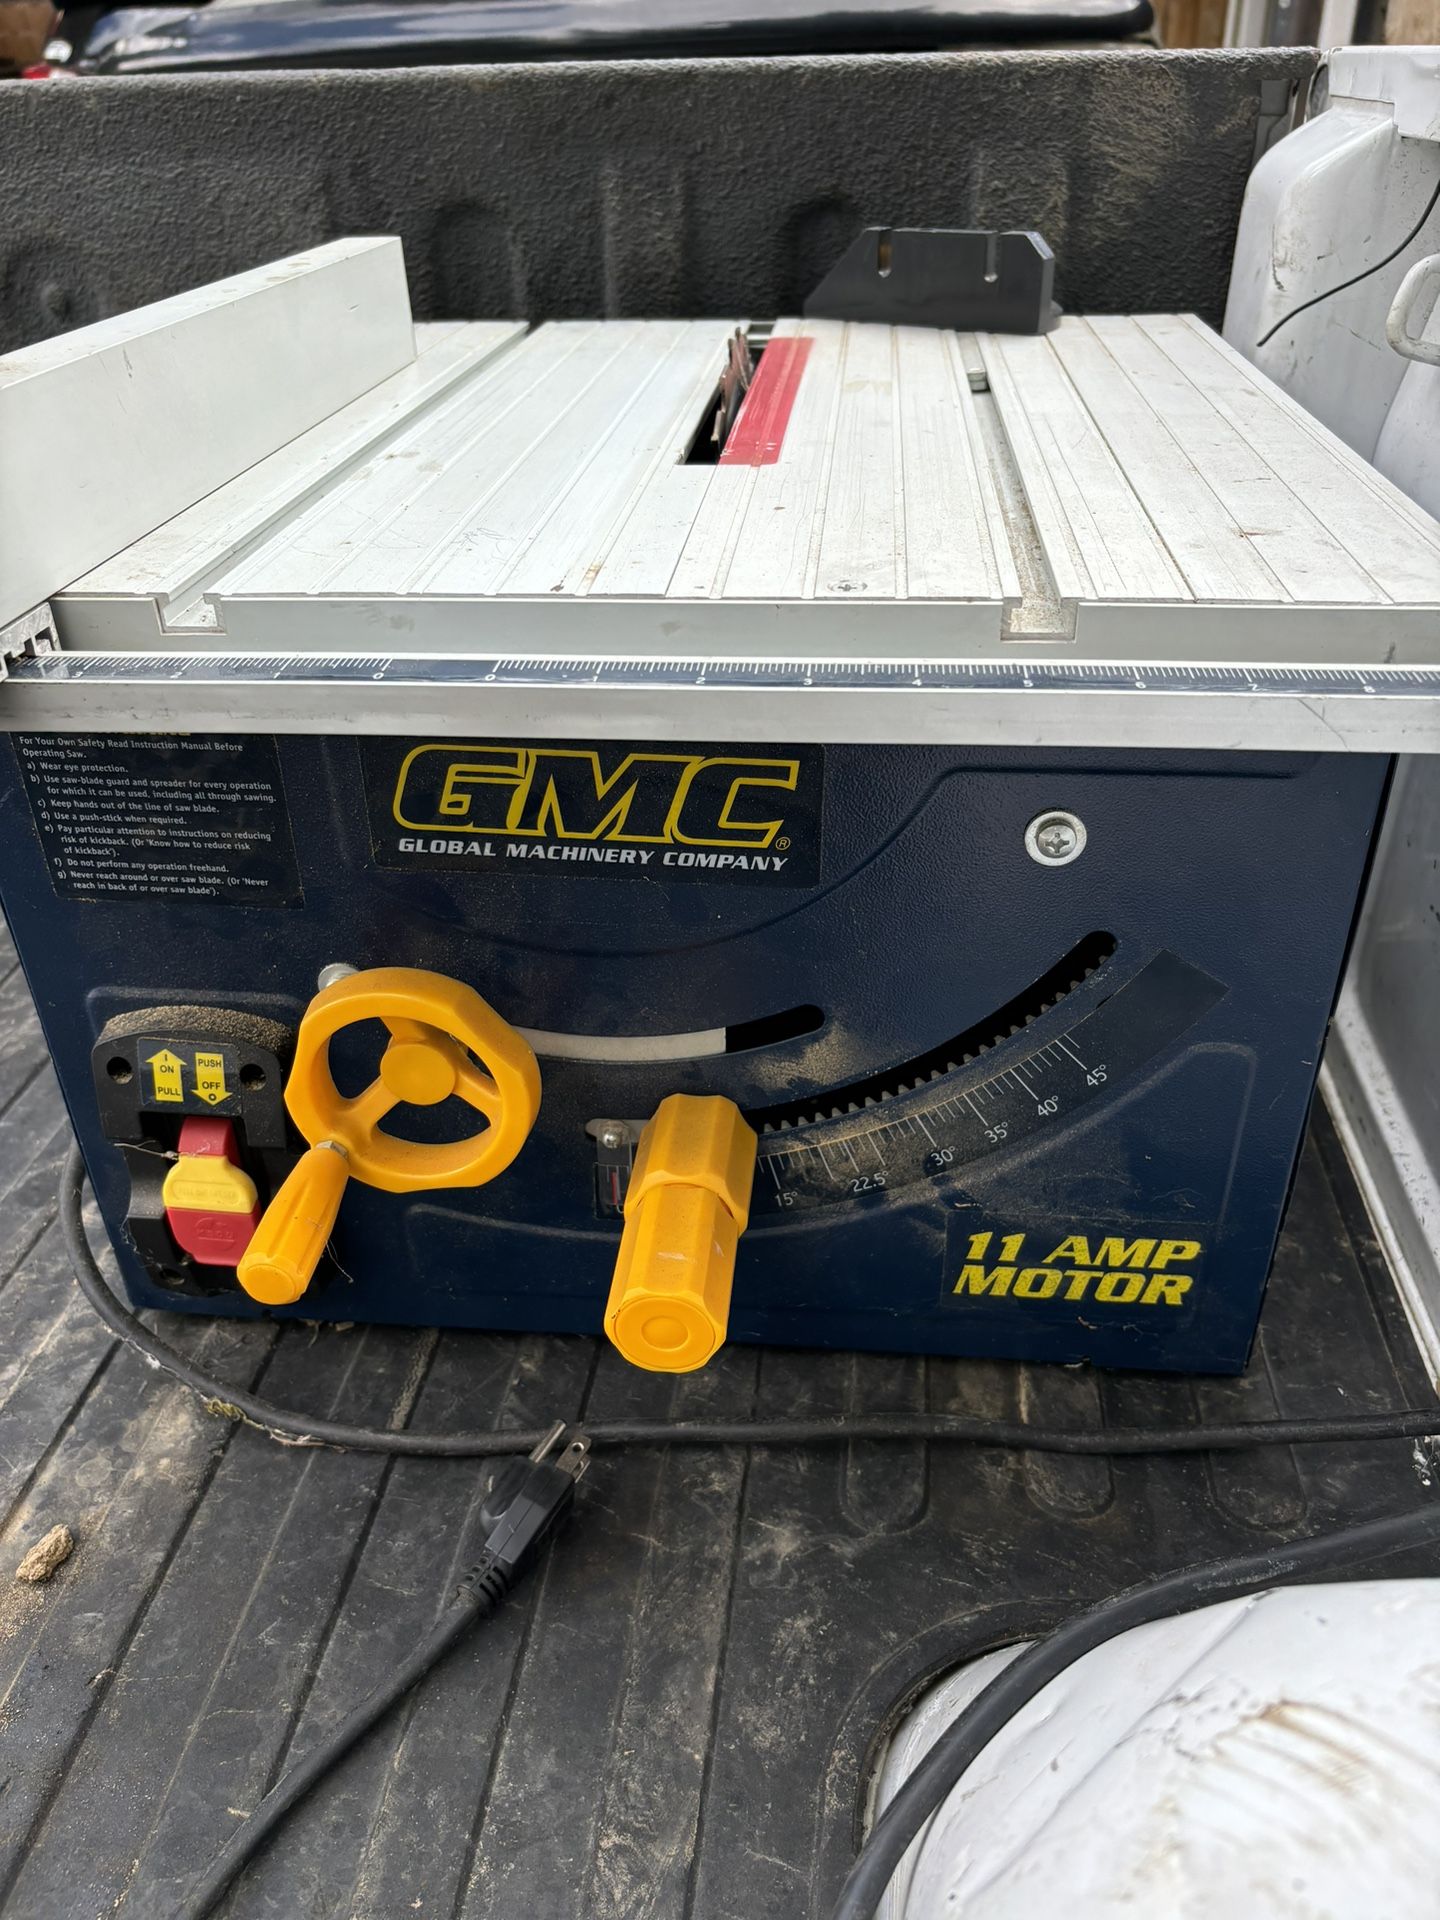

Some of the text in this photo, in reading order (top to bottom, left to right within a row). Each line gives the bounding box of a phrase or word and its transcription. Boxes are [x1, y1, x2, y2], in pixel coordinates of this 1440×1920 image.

[373, 672, 384, 680] 0
[485, 674, 496, 682] 0
[696, 677, 706, 685] 2
[803, 678, 813, 686] 3
[912, 679, 922, 687] 4
[1023, 680, 1033, 688] 5
[19, 737, 243, 752] For Your Own Safety Read Instruction Manual Before
[23, 748, 87, 759] Operating Saw.
[27, 762, 129, 773] a) Wear eye protection.
[30, 775, 40, 784] b)
[44, 775, 60, 784] Use
[106, 778, 130, 788] guard
[132, 778, 148, 787] and
[150, 780, 186, 789] spreader
[189, 780, 201, 788] for
[204, 782, 227, 791] every
[229, 782, 272, 791] operation
[47, 786, 59, 795] for
[62, 787, 87, 796] which
[89, 788, 96, 796] it
[98, 789, 113, 797] can
[115, 789, 126, 797] be
[153, 791, 192, 800] including
[194, 792, 206, 800] all
[208, 793, 241, 802] through
[243, 794, 277, 803] sawing.
[393, 744, 800, 849] GMC
[37, 800, 46, 809] c)
[50, 800, 72, 809] Keep
[74, 800, 99, 809] hands
[117, 801, 126, 809] of
[128, 802, 143, 810] the
[145, 803, 161, 811] line
[193, 804, 220, 813] blade.
[41, 812, 51, 821] d)
[54, 812, 69, 820] Use
[80, 814, 122, 823] push-stick
[124, 815, 147, 823] when
[149, 816, 188, 825] required.
[44, 824, 54, 834] e)
[57, 824, 72, 834] Pay
[75, 825, 114, 835] particular
[117, 827, 156, 836] attention
[158, 828, 167, 836] to
[168, 829, 219, 838] instructions
[234, 831, 271, 841] reducing
[61, 836, 77, 844] risk
[78, 836, 88, 844] of
[90, 837, 129, 846] kickback.
[173, 840, 191, 848] how
[192, 841, 202, 849] to
[204, 841, 232, 850] reduce
[234, 842, 251, 850] risk
[64, 846, 73, 854] of
[399, 838, 789, 872] GLOBAL MACHINERY COMPANY
[54, 858, 229, 873] f) Do not perform any operation freehand.
[57, 870, 67, 879] g)
[70, 870, 94, 879] Never
[96, 871, 118, 880] reach
[120, 872, 148, 881] around
[198, 876, 225, 885] blade.
[73, 882, 96, 890] reach
[97, 882, 105, 890] in
[107, 883, 127, 891] back
[129, 883, 138, 891] of
[160, 1065, 174, 1074] ON
[198, 1059, 222, 1068] PUSH
[1085, 1064, 1108, 1088] 45°
[158, 1087, 181, 1096] PULL
[202, 1081, 221, 1090] OFF
[1036, 1095, 1060, 1118] 40°
[983, 1122, 1009, 1144] 35°
[930, 1146, 956, 1167] 30°
[850, 1171, 889, 1193] 22.5°
[966, 1232, 1201, 1269] 11 AMP
[952, 1265, 1194, 1305] MOTOR
